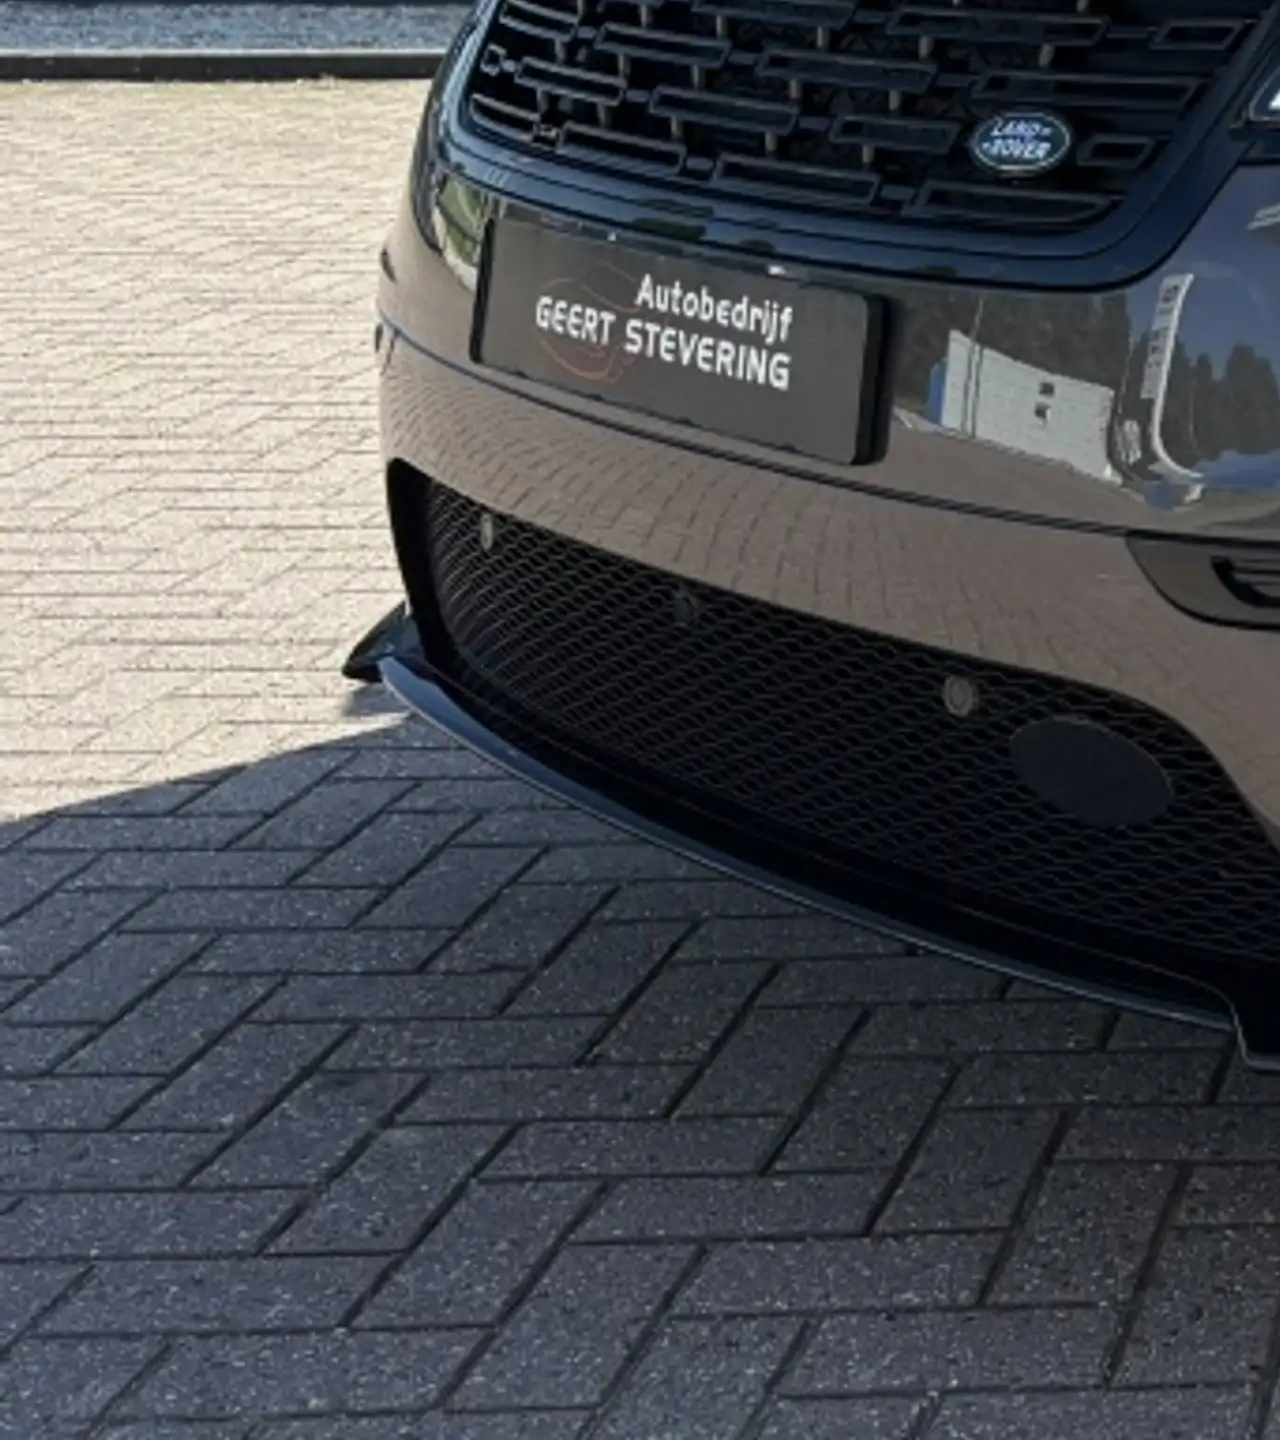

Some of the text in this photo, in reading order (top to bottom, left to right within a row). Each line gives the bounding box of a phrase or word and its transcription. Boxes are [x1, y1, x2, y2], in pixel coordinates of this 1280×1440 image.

[535, 295, 792, 392] GEERT STEVERING
[634, 273, 793, 344] Autobedrijf
